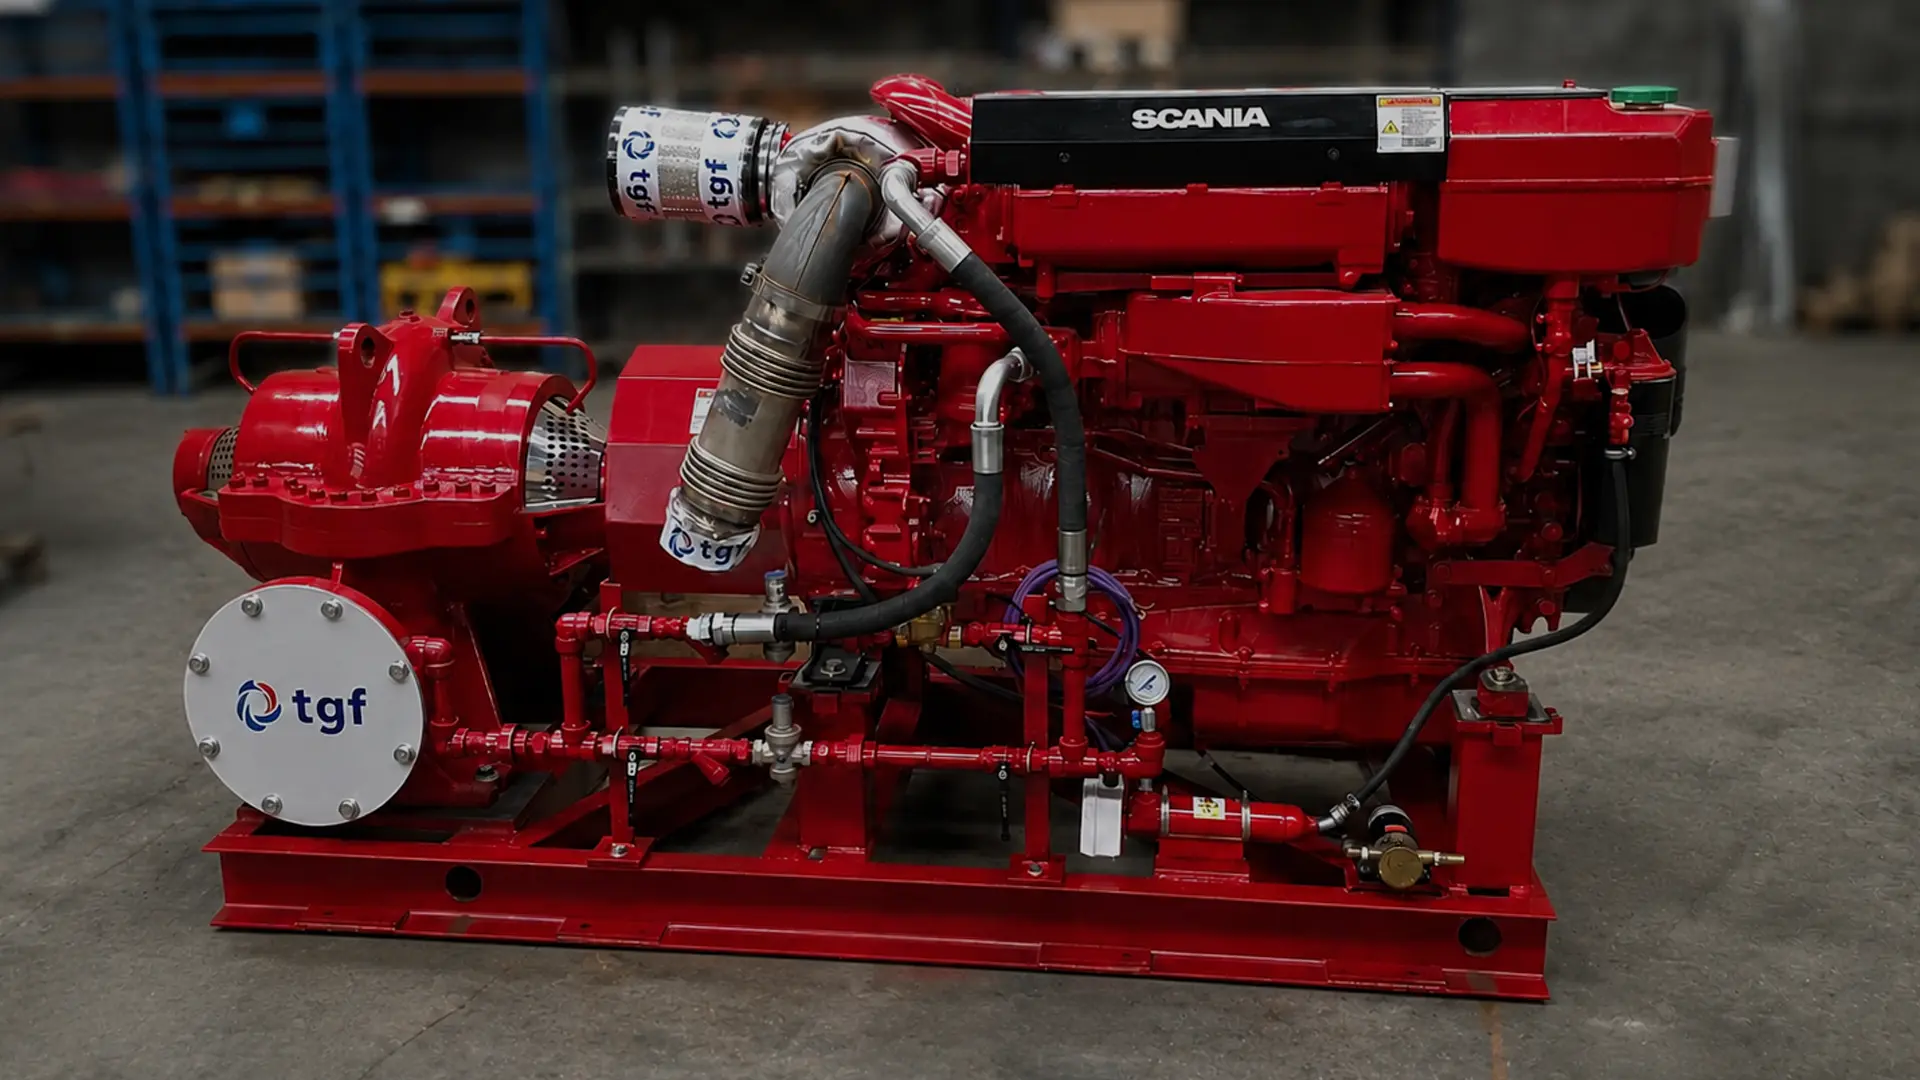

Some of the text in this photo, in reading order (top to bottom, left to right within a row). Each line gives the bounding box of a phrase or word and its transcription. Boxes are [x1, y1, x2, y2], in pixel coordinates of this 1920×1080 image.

[1131, 106, 1270, 129] SCANIA
[626, 168, 659, 215] tgf
[704, 158, 734, 210] tgf
[291, 687, 367, 735] tgf
